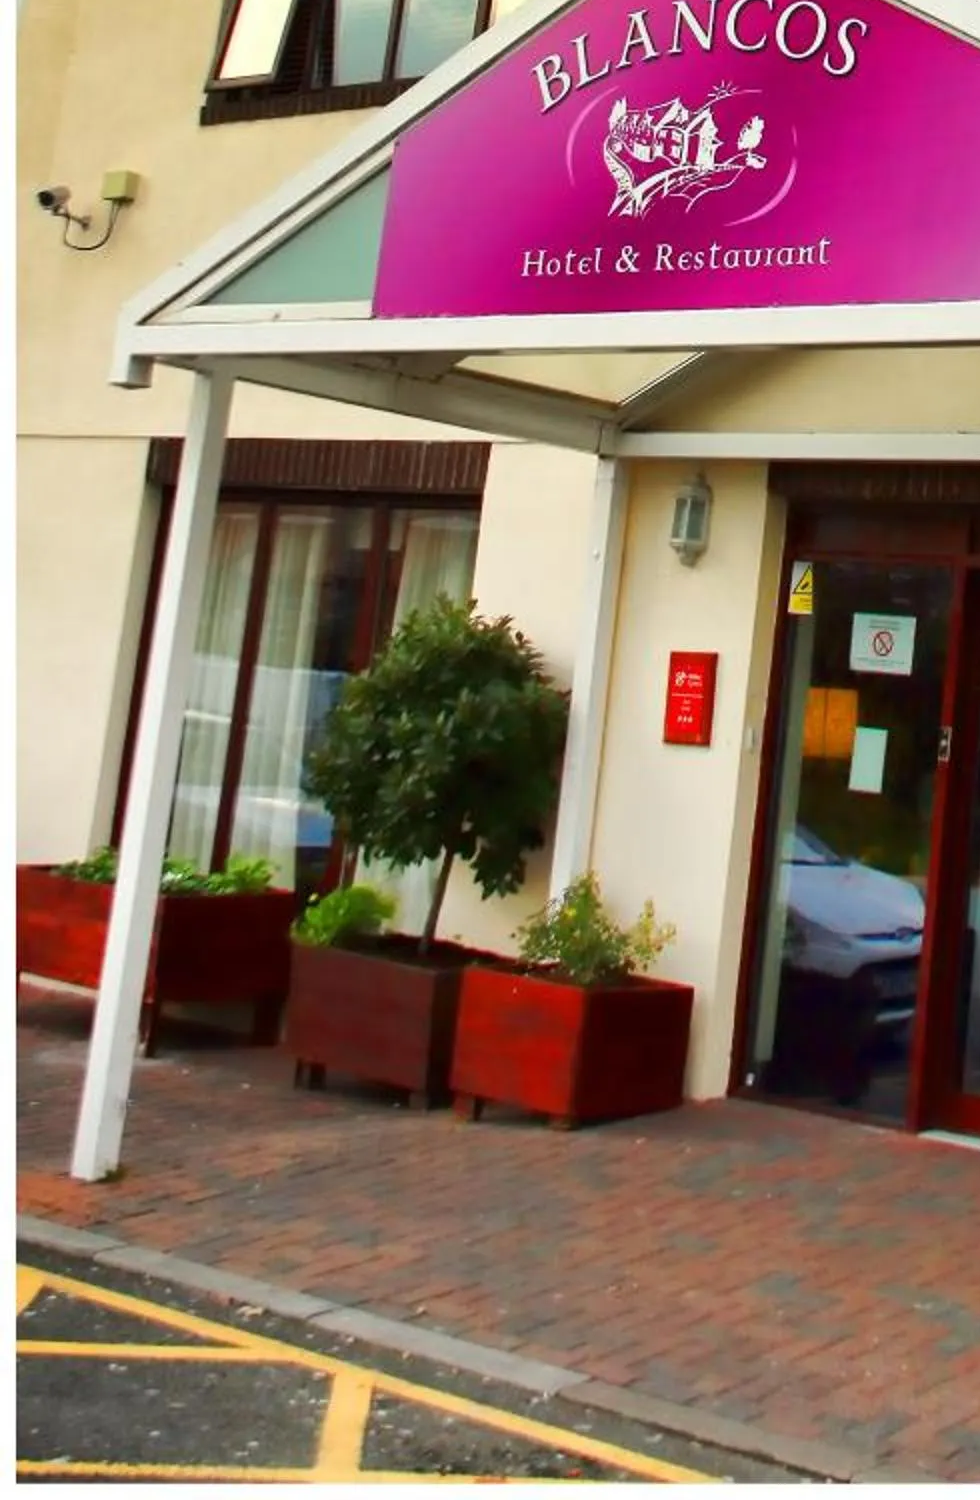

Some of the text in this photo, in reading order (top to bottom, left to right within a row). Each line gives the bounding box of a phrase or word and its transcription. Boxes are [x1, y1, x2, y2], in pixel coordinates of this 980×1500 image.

[520, 235, 832, 277] Hotel & Restaurant
